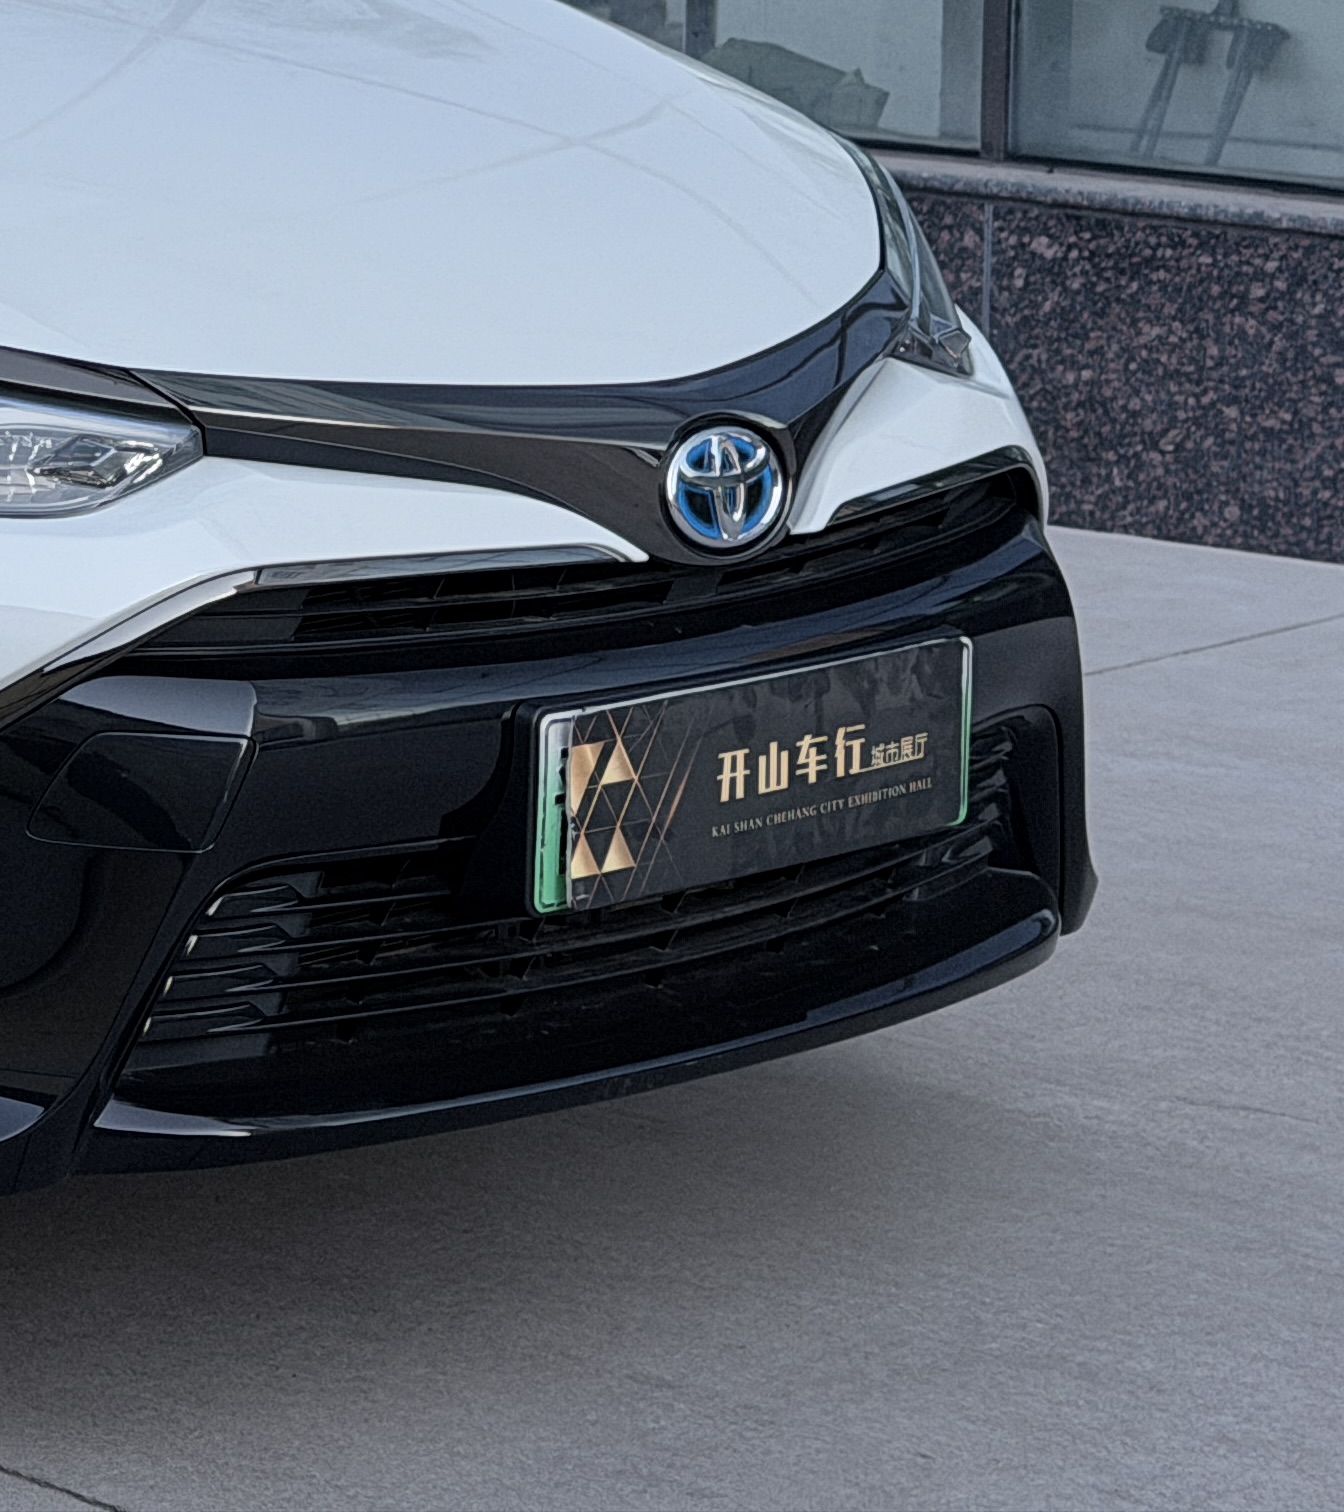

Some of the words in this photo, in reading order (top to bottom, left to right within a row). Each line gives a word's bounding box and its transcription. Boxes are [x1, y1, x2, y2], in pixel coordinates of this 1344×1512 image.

[716, 723, 867, 803] 开山车行
[711, 824, 731, 838] KAI
[733, 816, 763, 834] SHAN
[766, 804, 818, 826] CHEHANG
[819, 797, 845, 815] CITY
[847, 782, 907, 808] EXHIBITION
[908, 776, 933, 793] HALL
